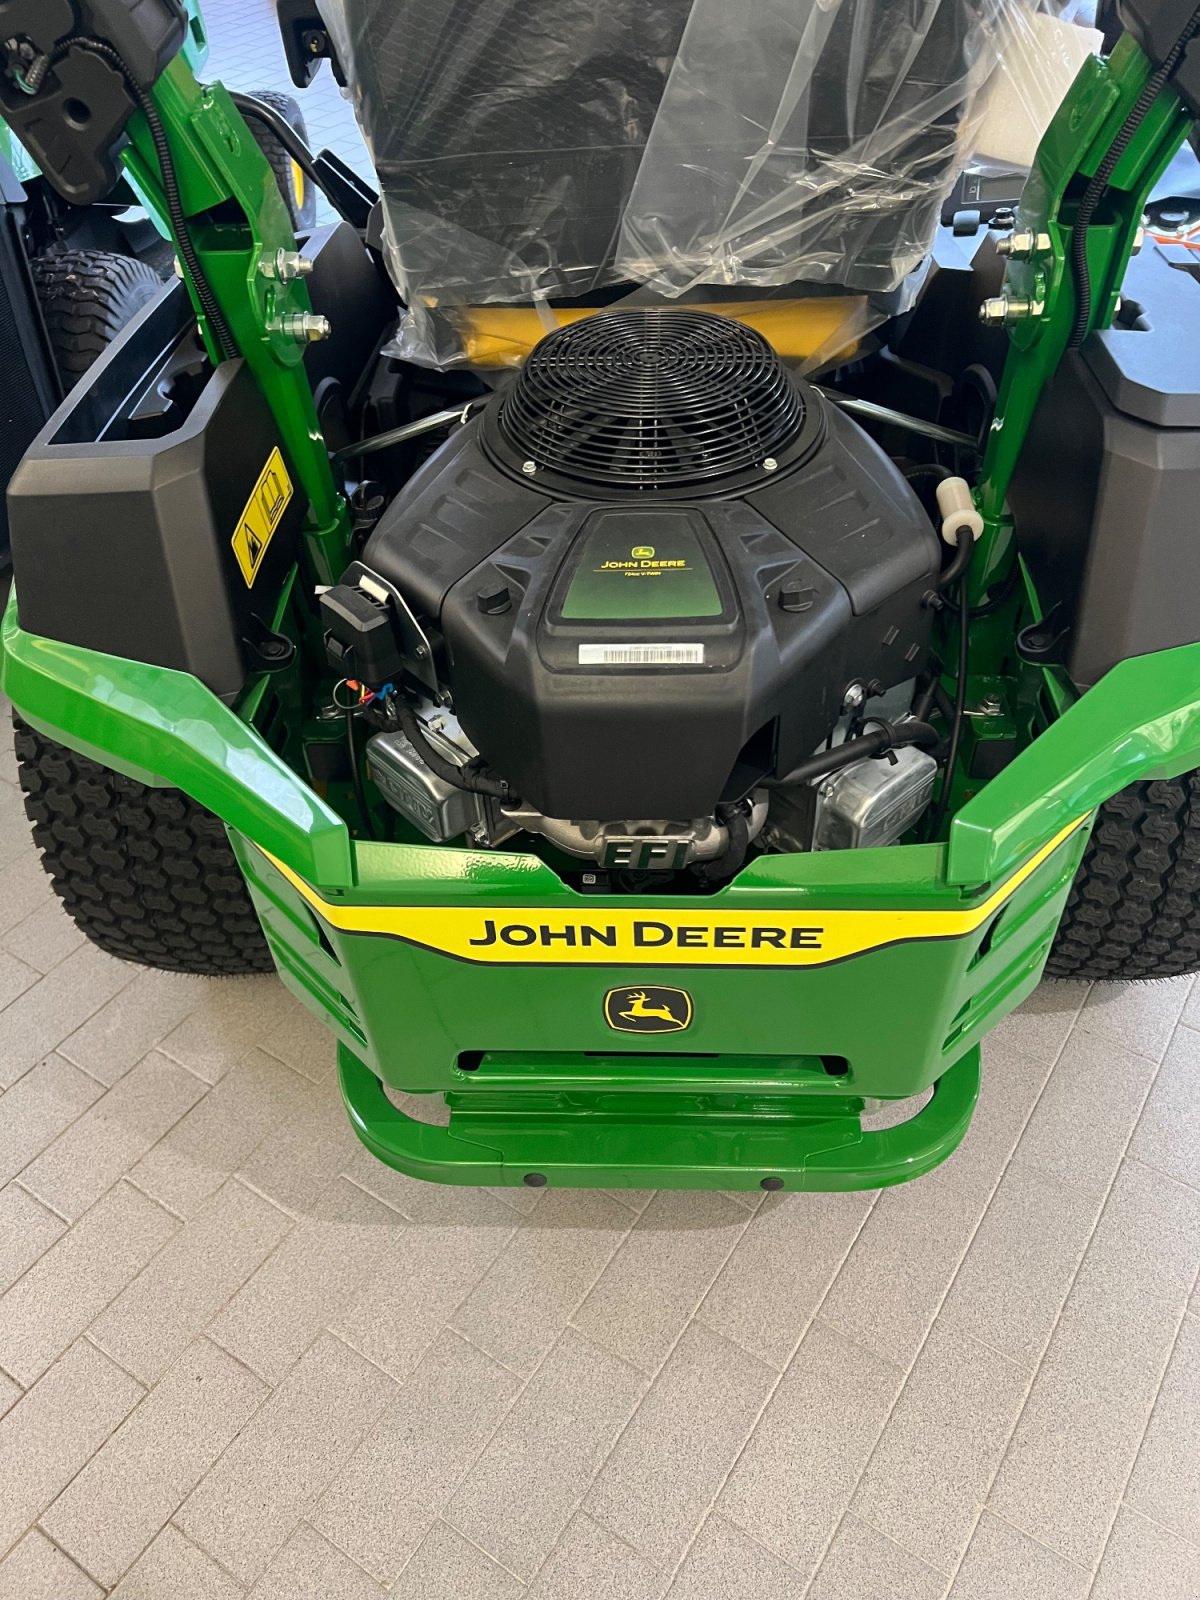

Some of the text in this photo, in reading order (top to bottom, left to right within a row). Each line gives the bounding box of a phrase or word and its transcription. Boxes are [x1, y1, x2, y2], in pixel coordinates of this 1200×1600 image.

[601, 560, 686, 569] JOHN DEERE
[603, 839, 690, 869] EFI
[469, 920, 824, 949] JOHN DEERE
